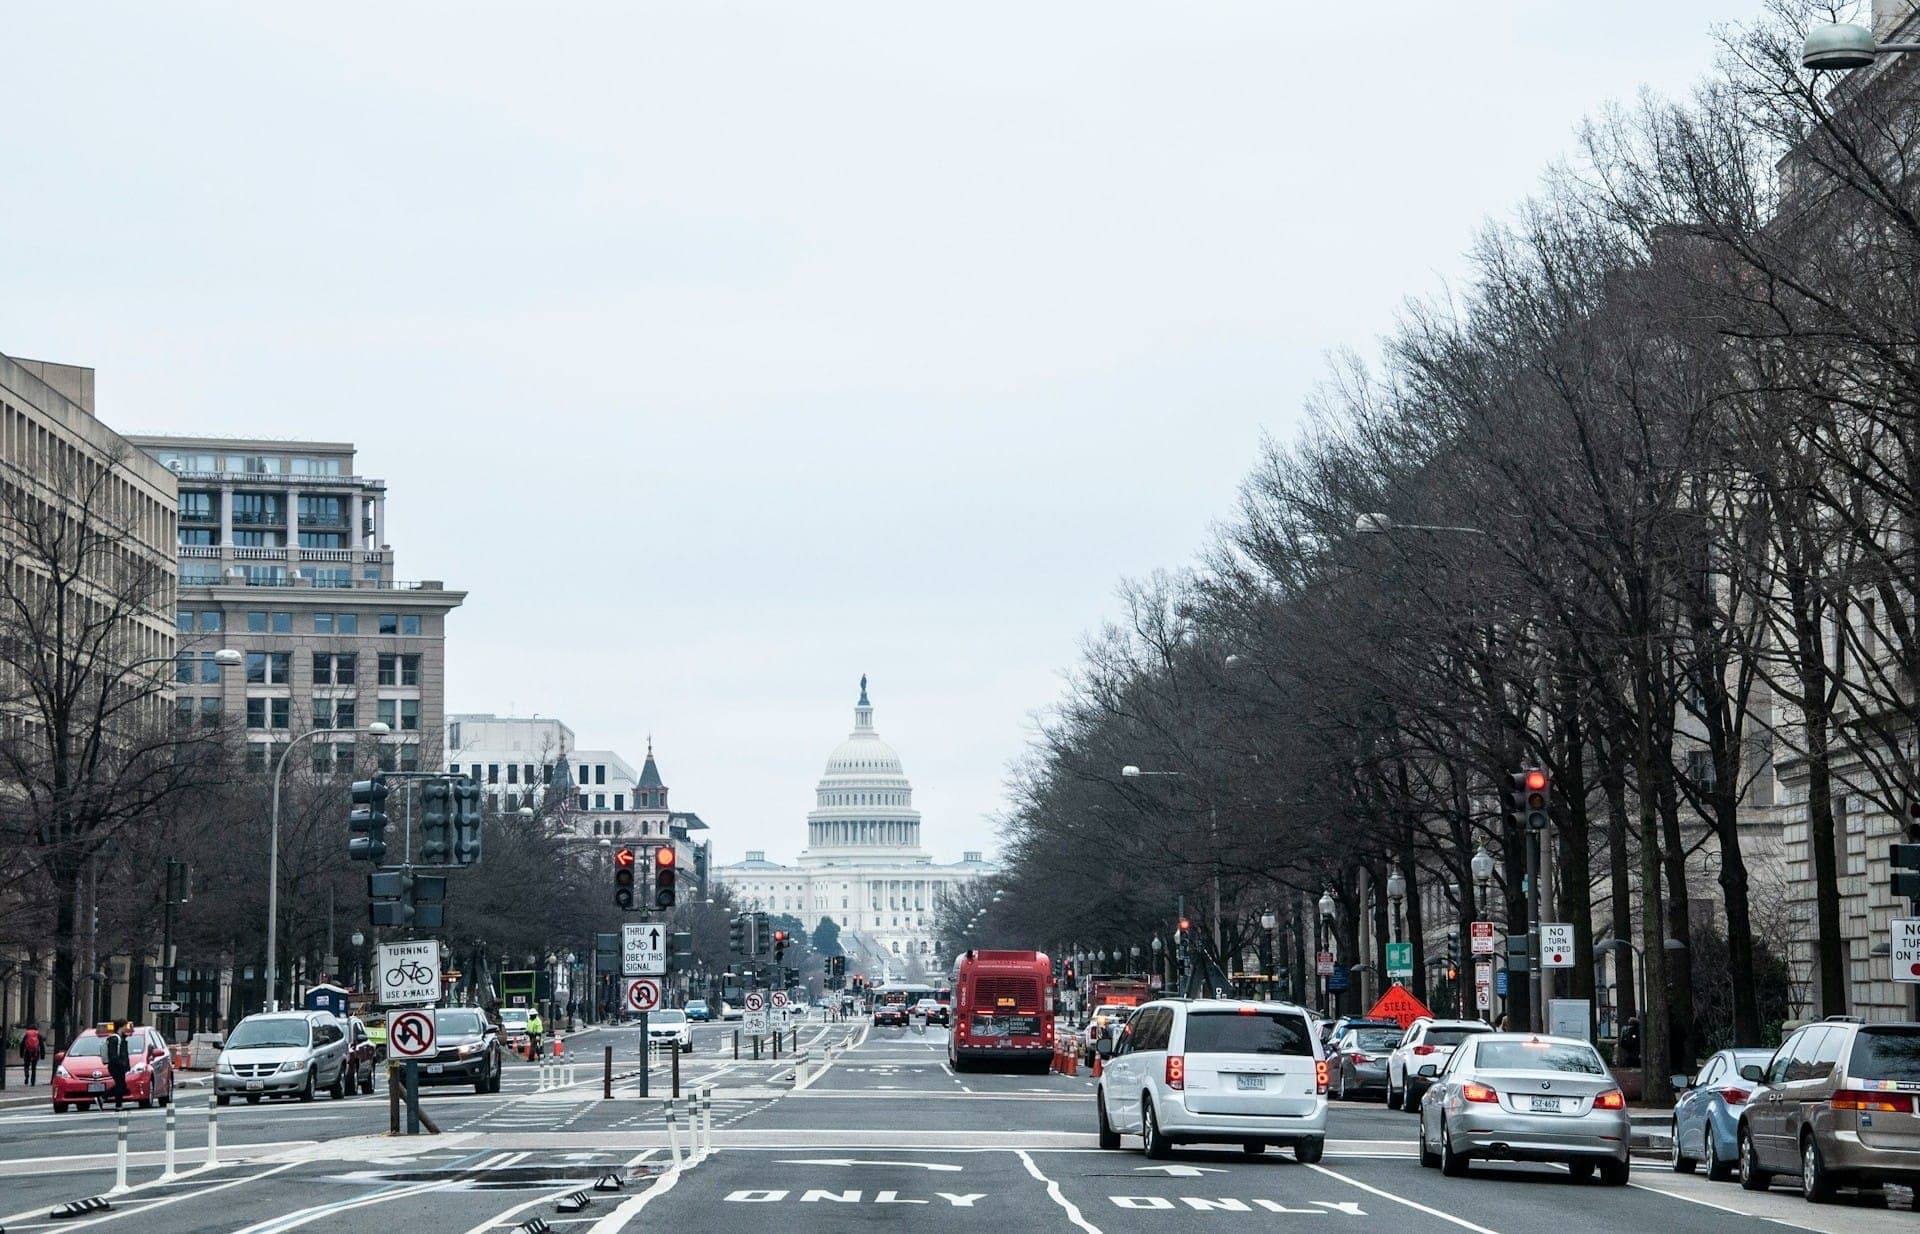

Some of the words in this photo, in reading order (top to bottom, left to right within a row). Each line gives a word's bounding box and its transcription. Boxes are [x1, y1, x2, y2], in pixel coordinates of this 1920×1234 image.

[626, 927, 645, 936] THRU
[1549, 927, 1564, 936] NO
[1547, 937, 1567, 945] TURN
[388, 946, 429, 956] TURNING
[1896, 950, 1911, 960] ON
[625, 953, 645, 962] OBEY
[648, 952, 663, 961] THIS
[625, 963, 651, 971] SIGNAL
[386, 990, 400, 999] USE
[402, 988, 435, 998] X-WALKS
[1384, 1002, 1413, 1012] STEEL
[723, 1189, 988, 1207] ONLY
[1108, 1196, 1368, 1216] ONLY
